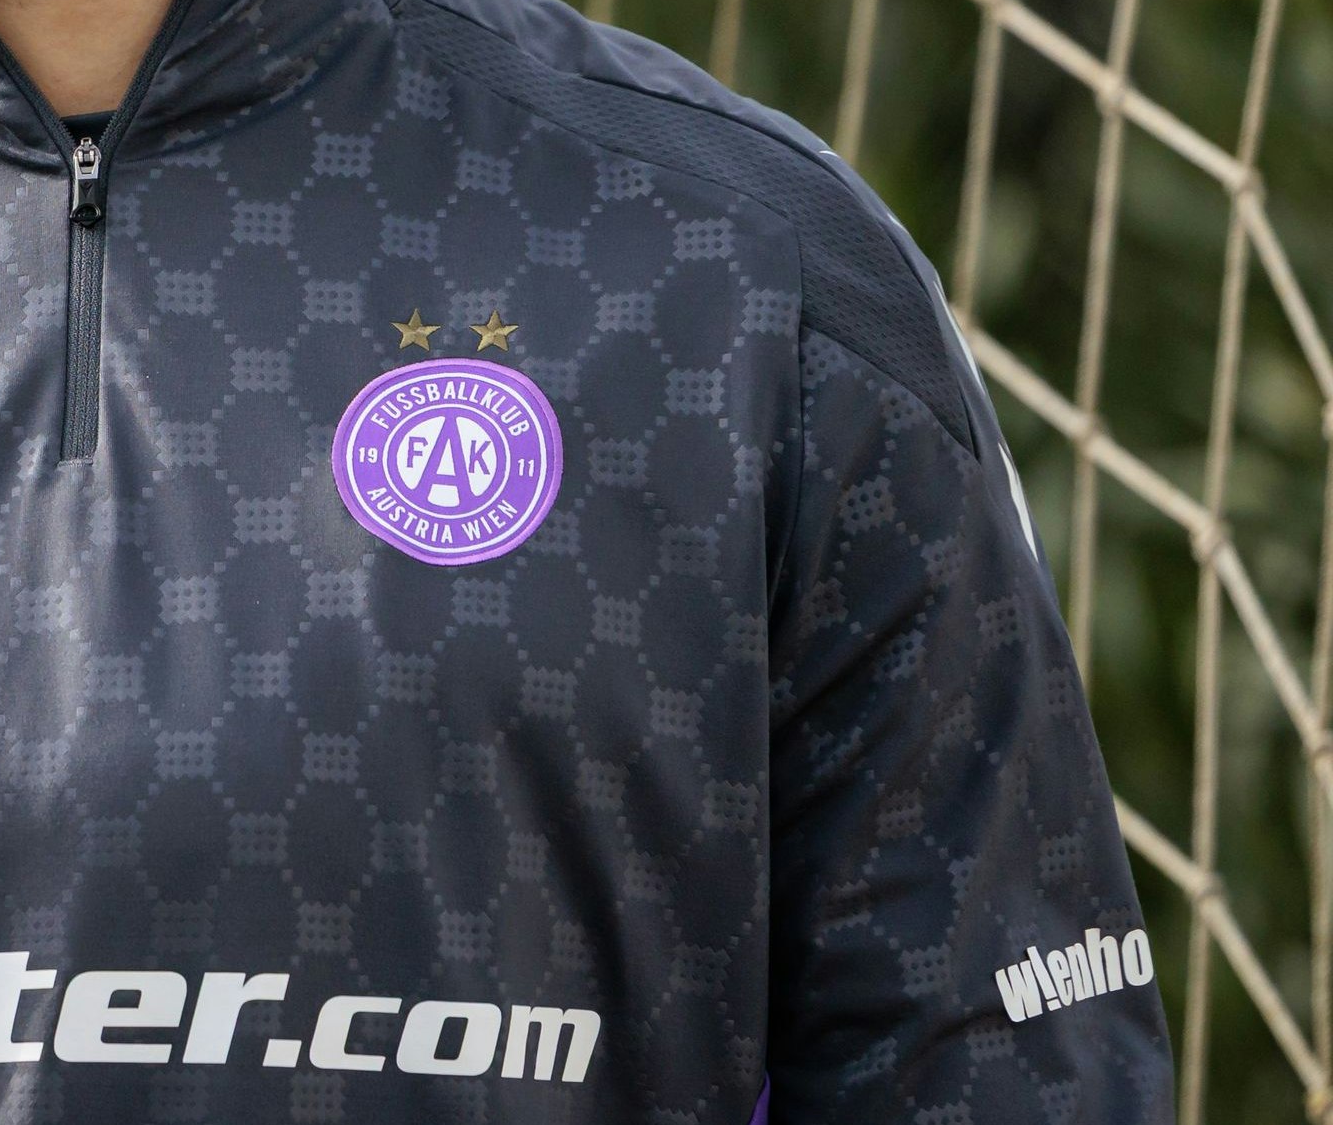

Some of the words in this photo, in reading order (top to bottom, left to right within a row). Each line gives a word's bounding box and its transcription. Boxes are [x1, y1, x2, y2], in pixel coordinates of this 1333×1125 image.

[370, 381, 531, 437] FUSSBALLKLUB
[358, 447, 379, 464] 19
[517, 458, 536, 477] 11
[366, 486, 454, 544] AUSTRIA
[461, 501, 518, 542] WIEN
